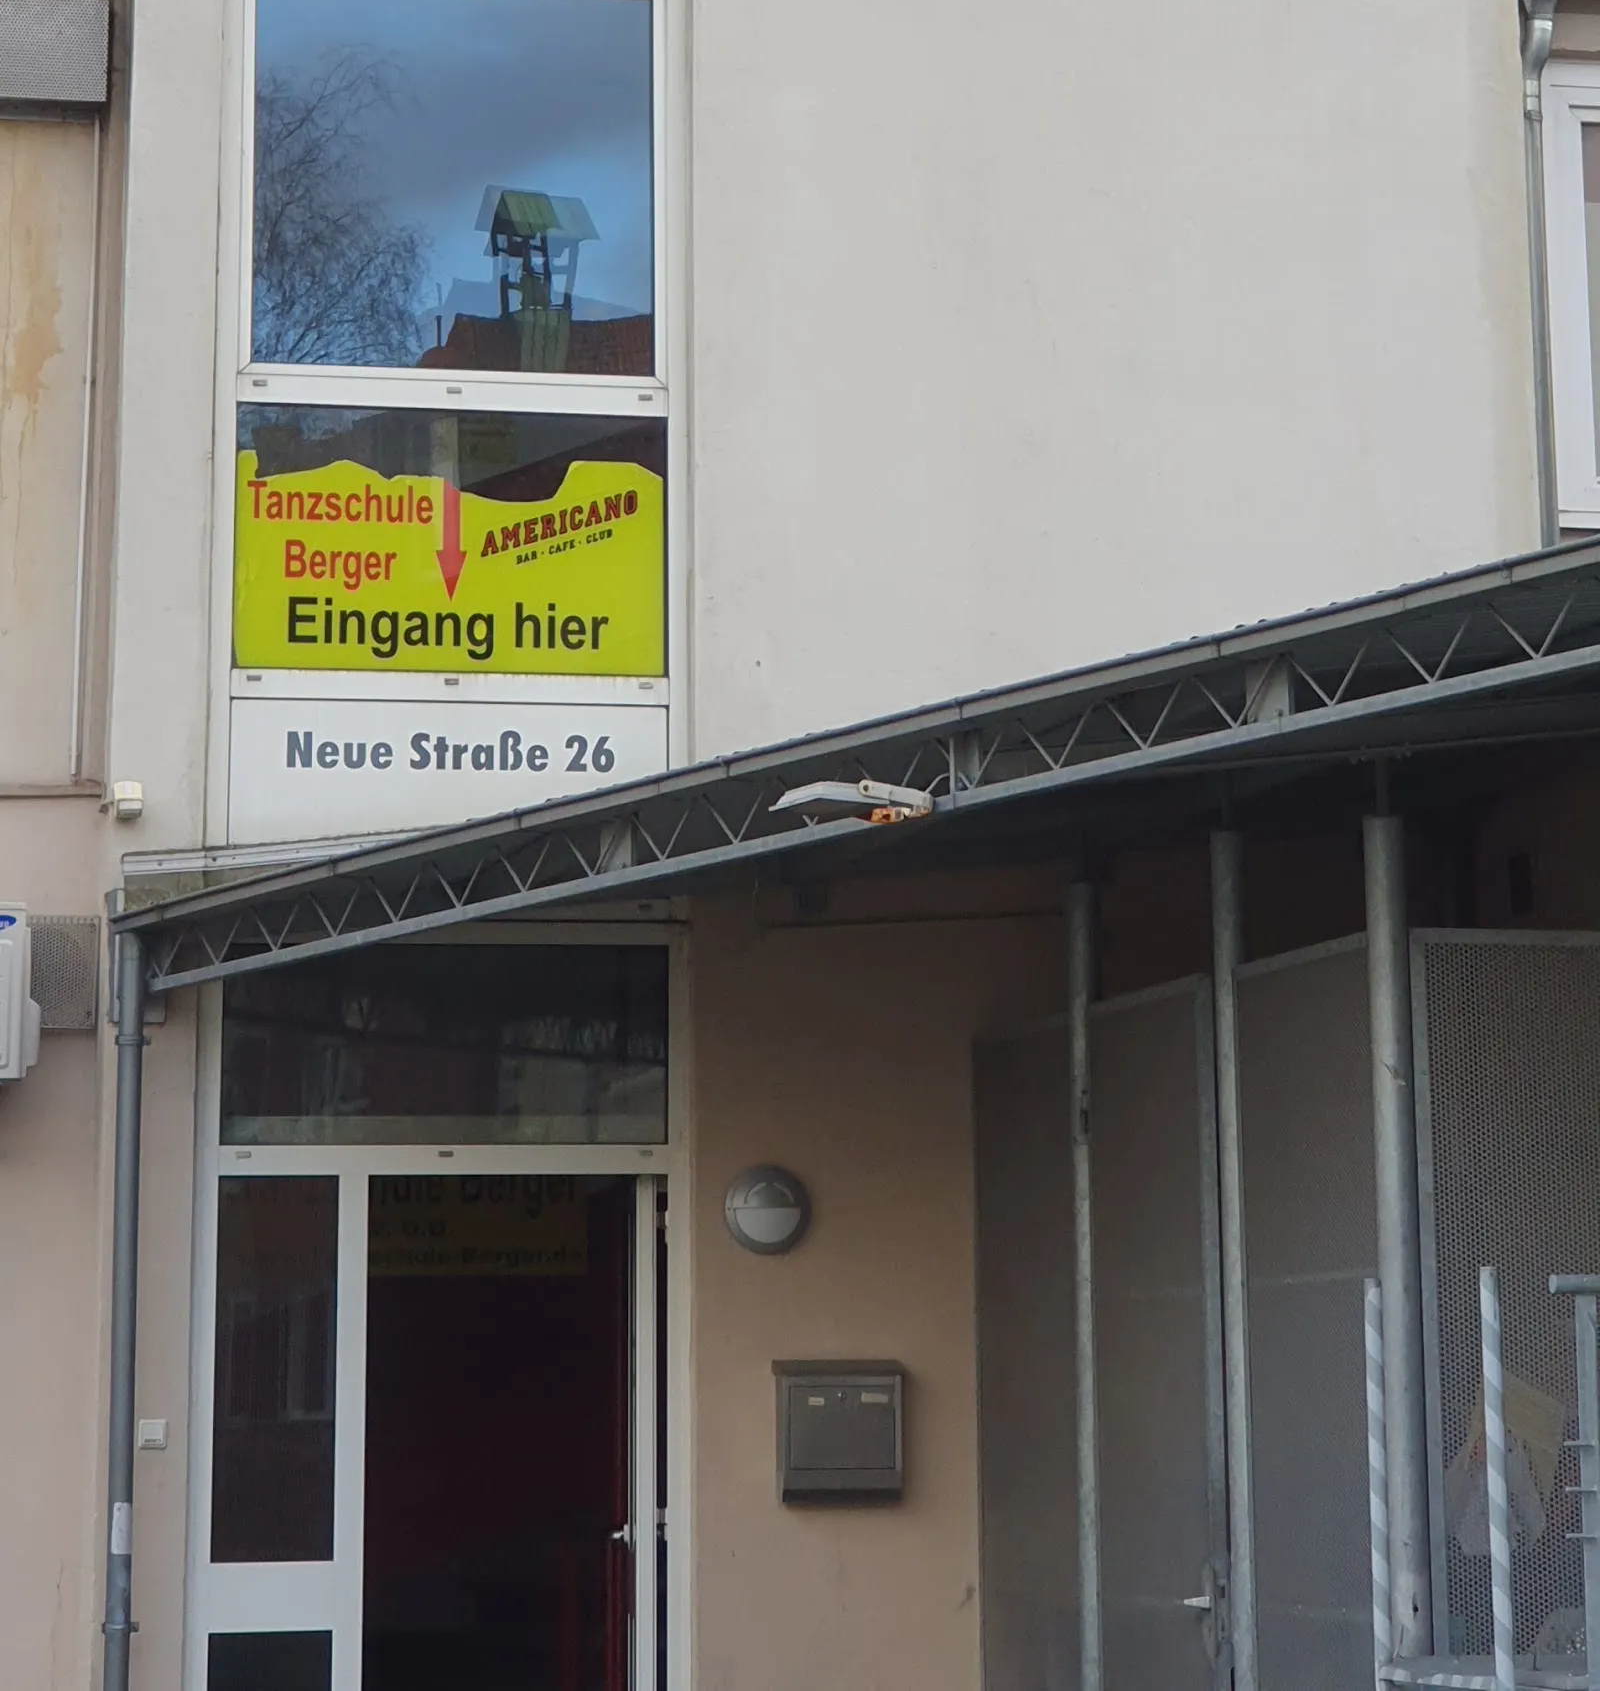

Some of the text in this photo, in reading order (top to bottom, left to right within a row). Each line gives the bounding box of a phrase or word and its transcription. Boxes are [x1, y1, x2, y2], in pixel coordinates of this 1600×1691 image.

[247, 480, 434, 526] Tanzschule
[481, 489, 638, 557] AMERICANO
[284, 539, 397, 591] Berger
[516, 529, 613, 565] BAR CAFE CLUB
[287, 596, 609, 661] Eingang hier
[285, 730, 616, 773] Neue Straße 26
